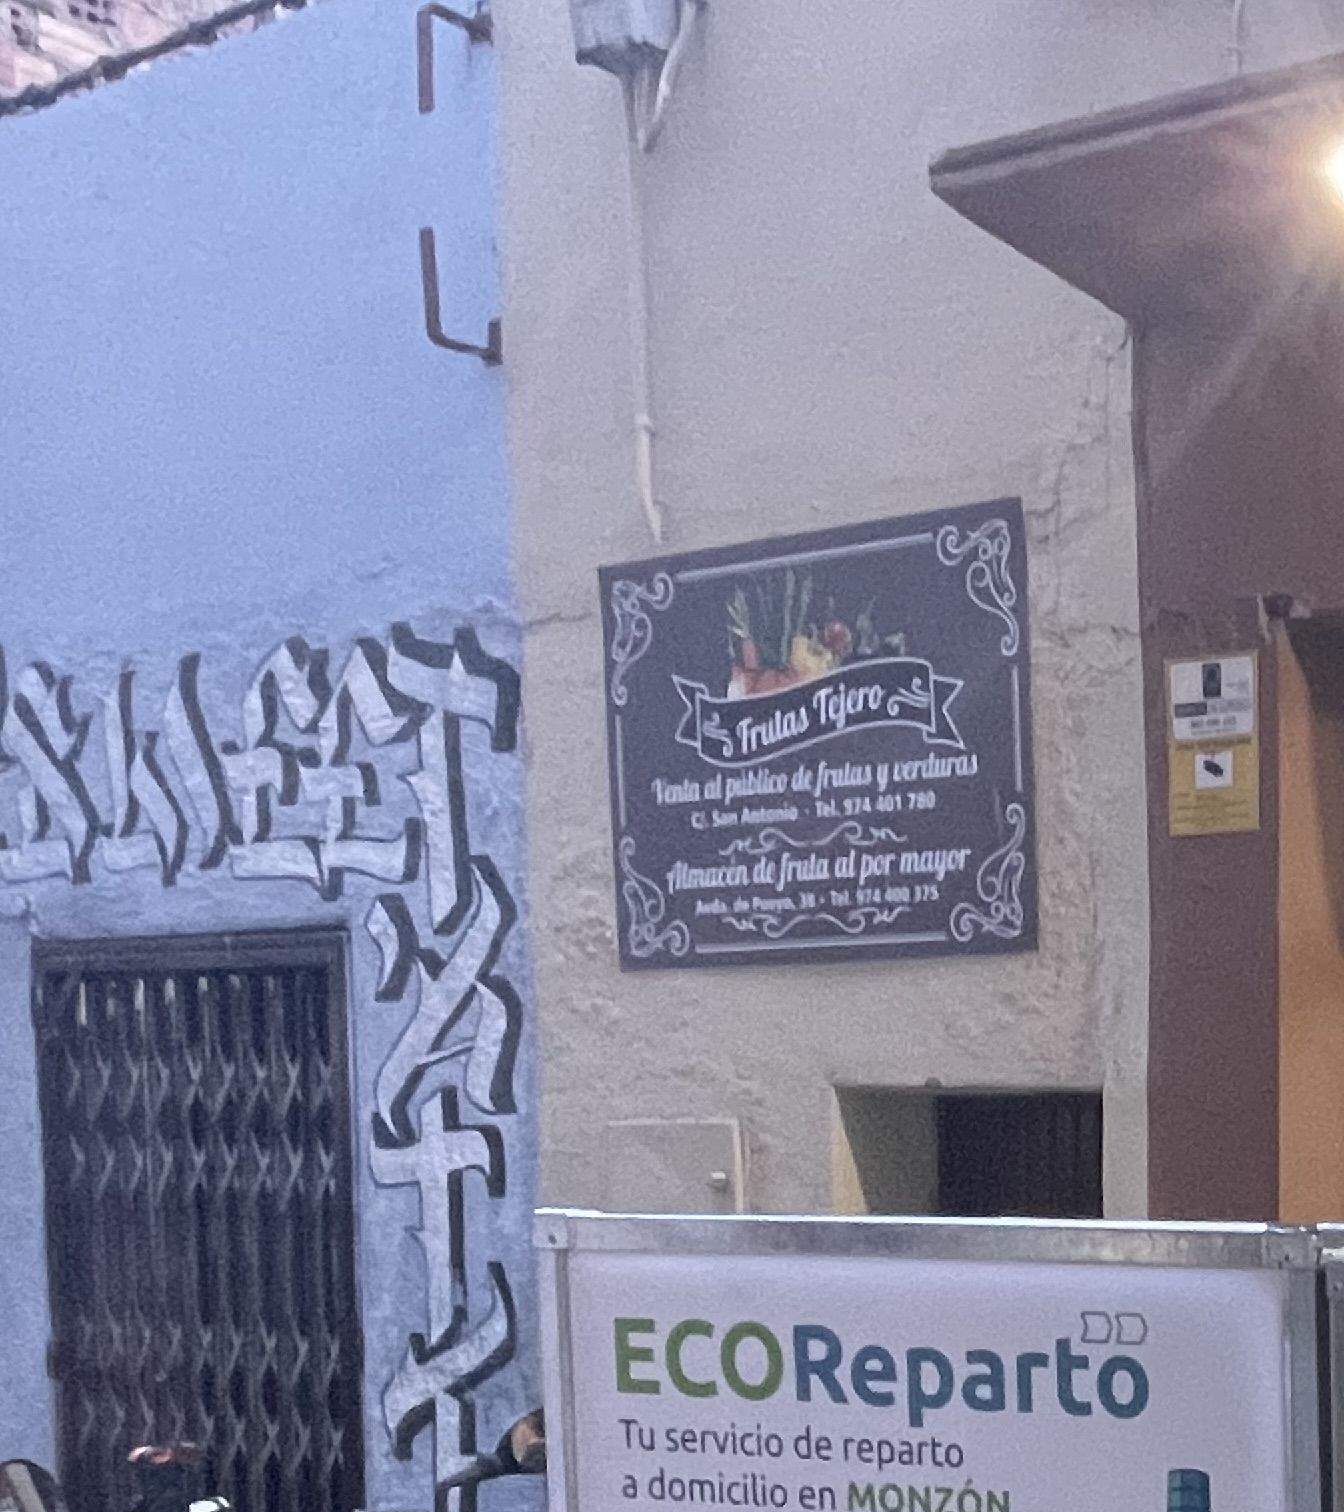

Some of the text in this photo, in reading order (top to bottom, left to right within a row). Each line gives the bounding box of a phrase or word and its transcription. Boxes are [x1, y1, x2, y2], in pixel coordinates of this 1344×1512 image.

[734, 683, 885, 756] Frutas Tejero
[652, 752, 977, 806] Venta al público de frutas y verduras
[753, 857, 775, 884] de
[776, 852, 829, 892] fruta
[835, 850, 856, 879] al
[859, 853, 895, 886] por
[900, 849, 972, 882] mayor
[613, 1317, 1150, 1427] ECOReparto
[618, 1418, 964, 1472] Tu servicio de reparto
[621, 1474, 638, 1500] a
[647, 1470, 789, 1509] domicilio
[798, 1484, 837, 1511] en
